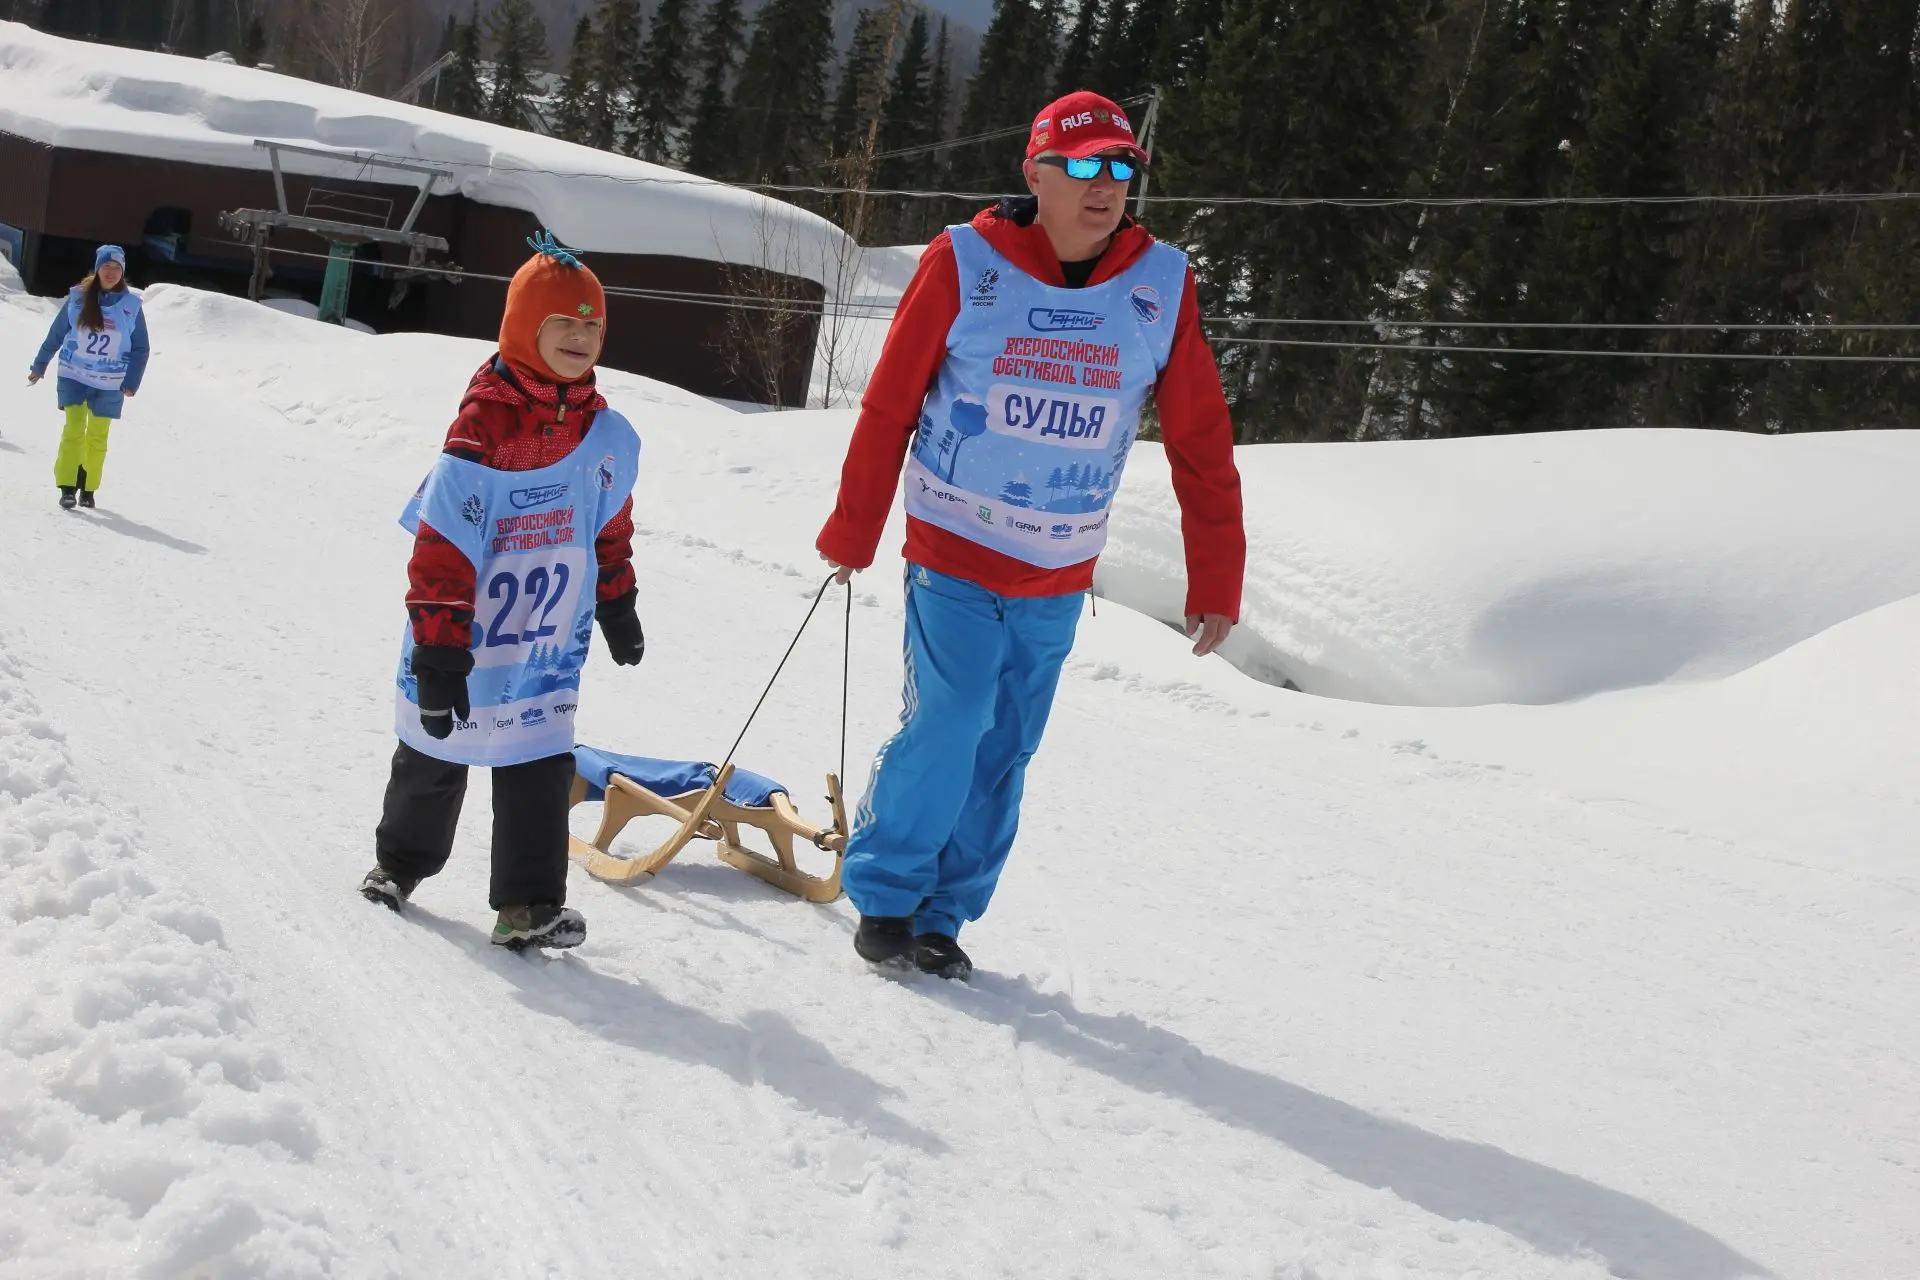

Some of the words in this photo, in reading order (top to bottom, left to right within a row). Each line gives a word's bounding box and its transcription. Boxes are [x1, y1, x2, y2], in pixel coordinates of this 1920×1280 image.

[1061, 112, 1093, 131] RUS
[86, 332, 111, 356] 22
[1004, 337, 1120, 367] ВСЕРОССИЙСКИЙ
[992, 356, 1077, 385] ФЕСТИВАЛЬ
[1083, 366, 1122, 390] САНОК
[1004, 393, 1106, 440] СУДЬЯ
[1015, 521, 1042, 533] GRM
[486, 563, 569, 648] 222
